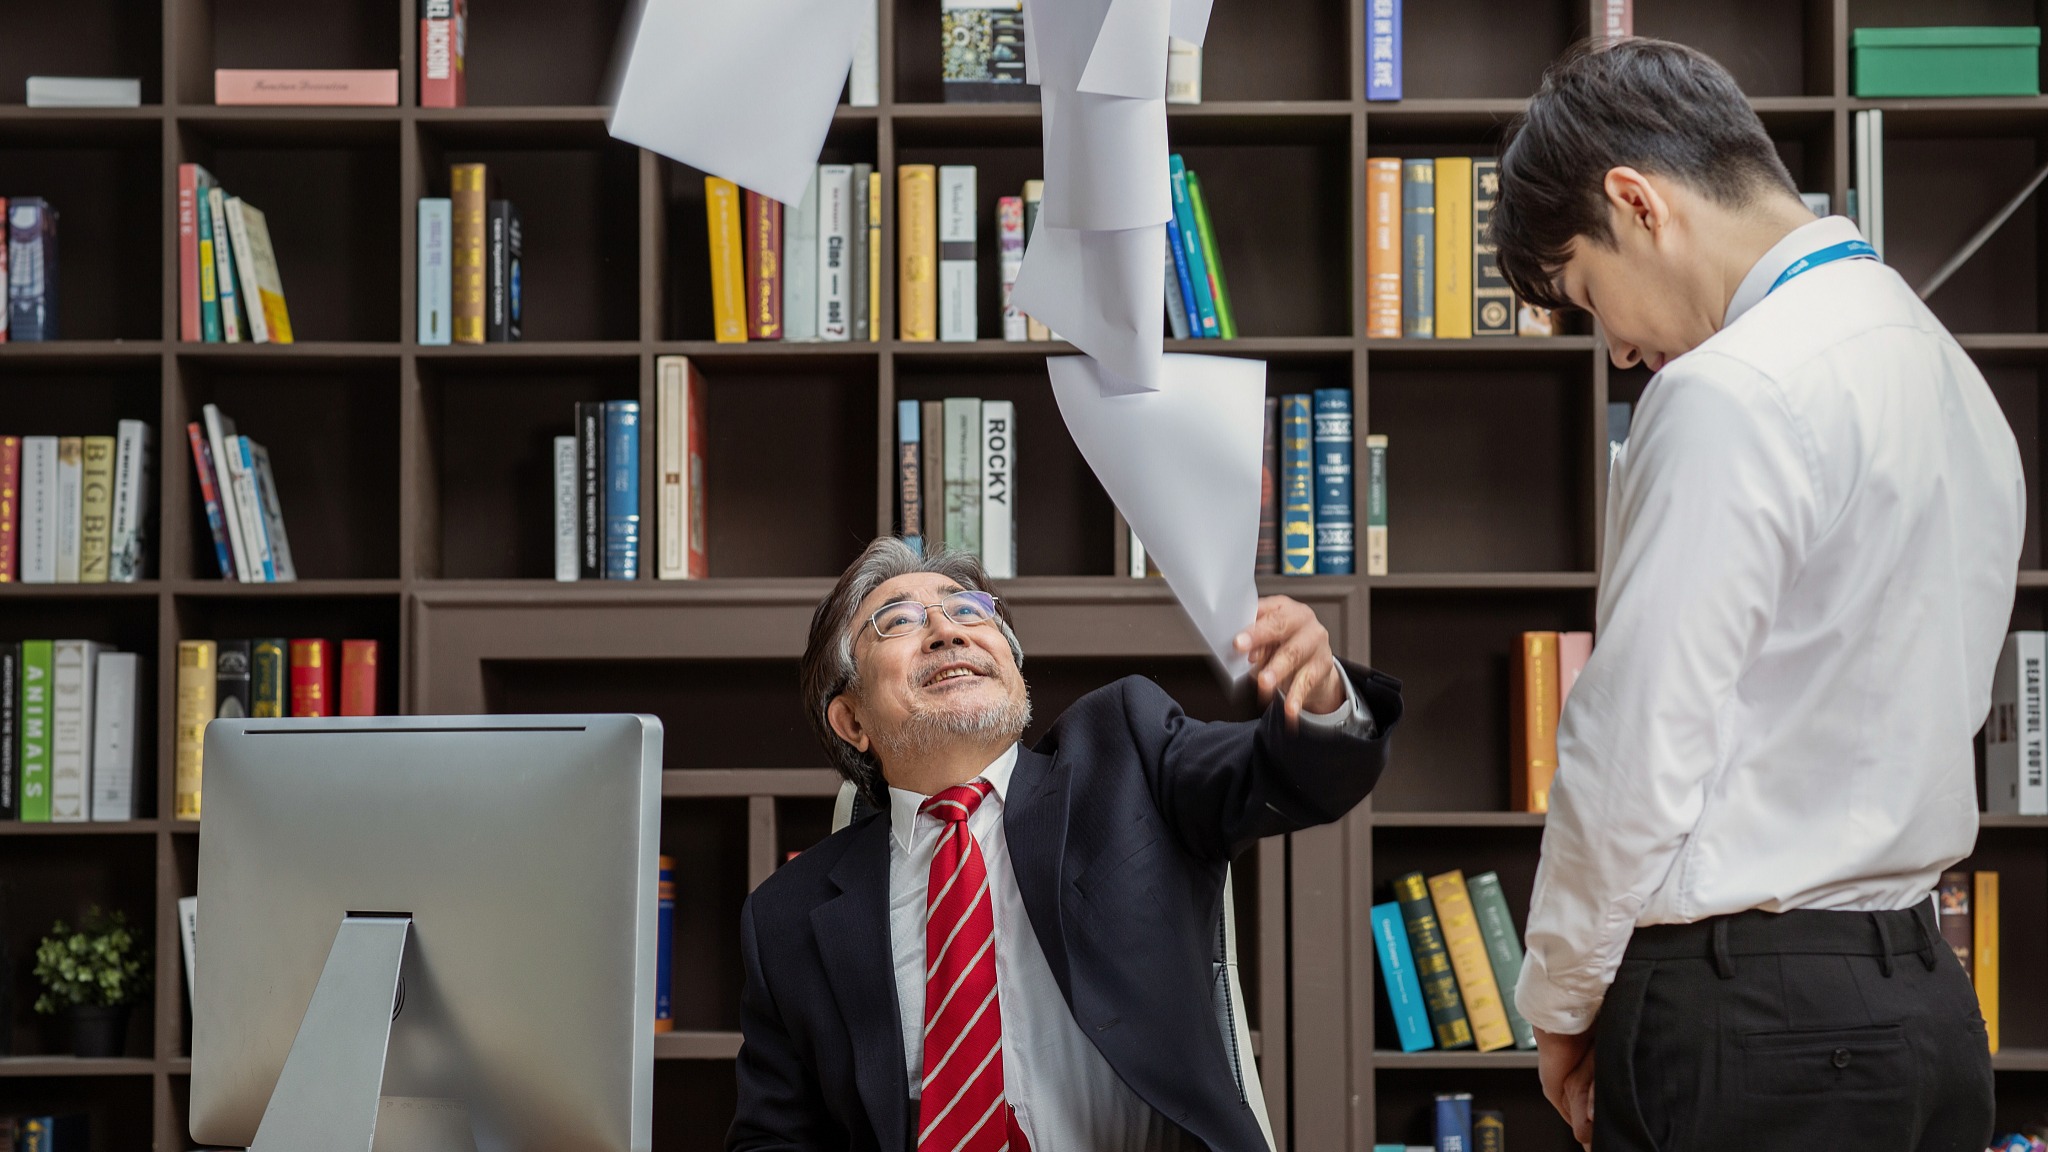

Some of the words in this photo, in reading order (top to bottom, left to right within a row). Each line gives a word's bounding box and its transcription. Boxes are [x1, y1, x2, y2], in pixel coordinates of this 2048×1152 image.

[427, 0, 449, 17] EL
[427, 19, 449, 79] JACKSON
[1374, 36, 1393, 60] THE
[1374, 61, 1393, 87] RYE
[560, 443, 577, 482] KELLY
[586, 416, 596, 469] ARCHITECTURE
[903, 444, 917, 465] THE
[988, 419, 1006, 504] ROCKY
[87, 443, 108, 504] BIG
[586, 470, 596, 479] IN
[586, 480, 596, 495] THE
[903, 466, 918, 501] SPEED
[560, 484, 576, 537] HOPPEN
[83, 514, 106, 576] BEN
[586, 534, 596, 568] CENTURY
[2027, 658, 2040, 732] BEAUTIFUL
[26, 665, 43, 798] ANIMALS
[2029, 740, 2041, 786] YOUTH
